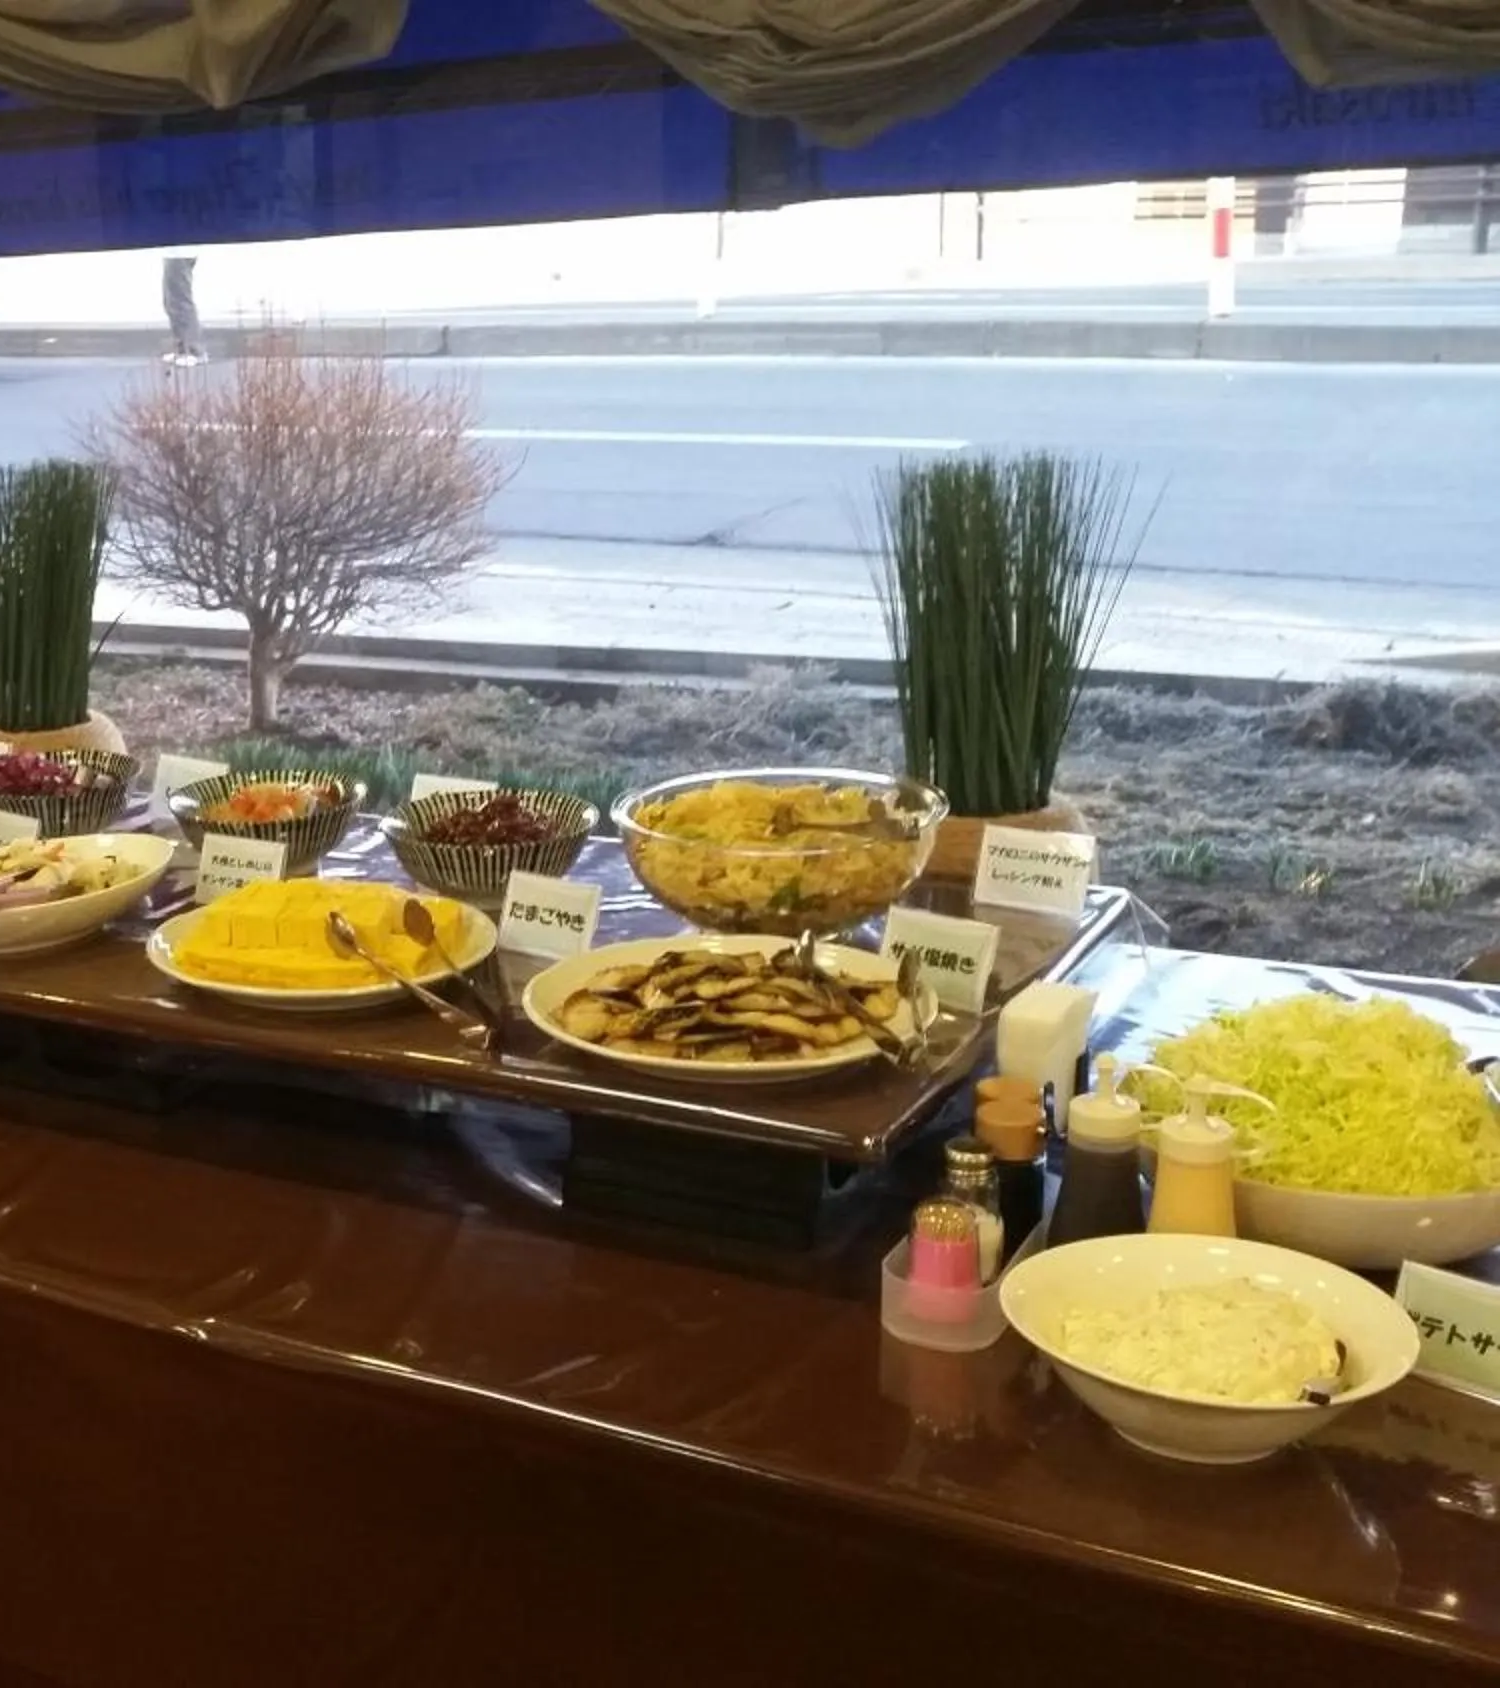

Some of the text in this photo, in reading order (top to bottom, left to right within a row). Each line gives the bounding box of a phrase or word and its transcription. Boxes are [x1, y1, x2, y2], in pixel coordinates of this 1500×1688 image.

[509, 901, 587, 934] たまごやき
[1407, 1309, 1500, 1355] テトサ
